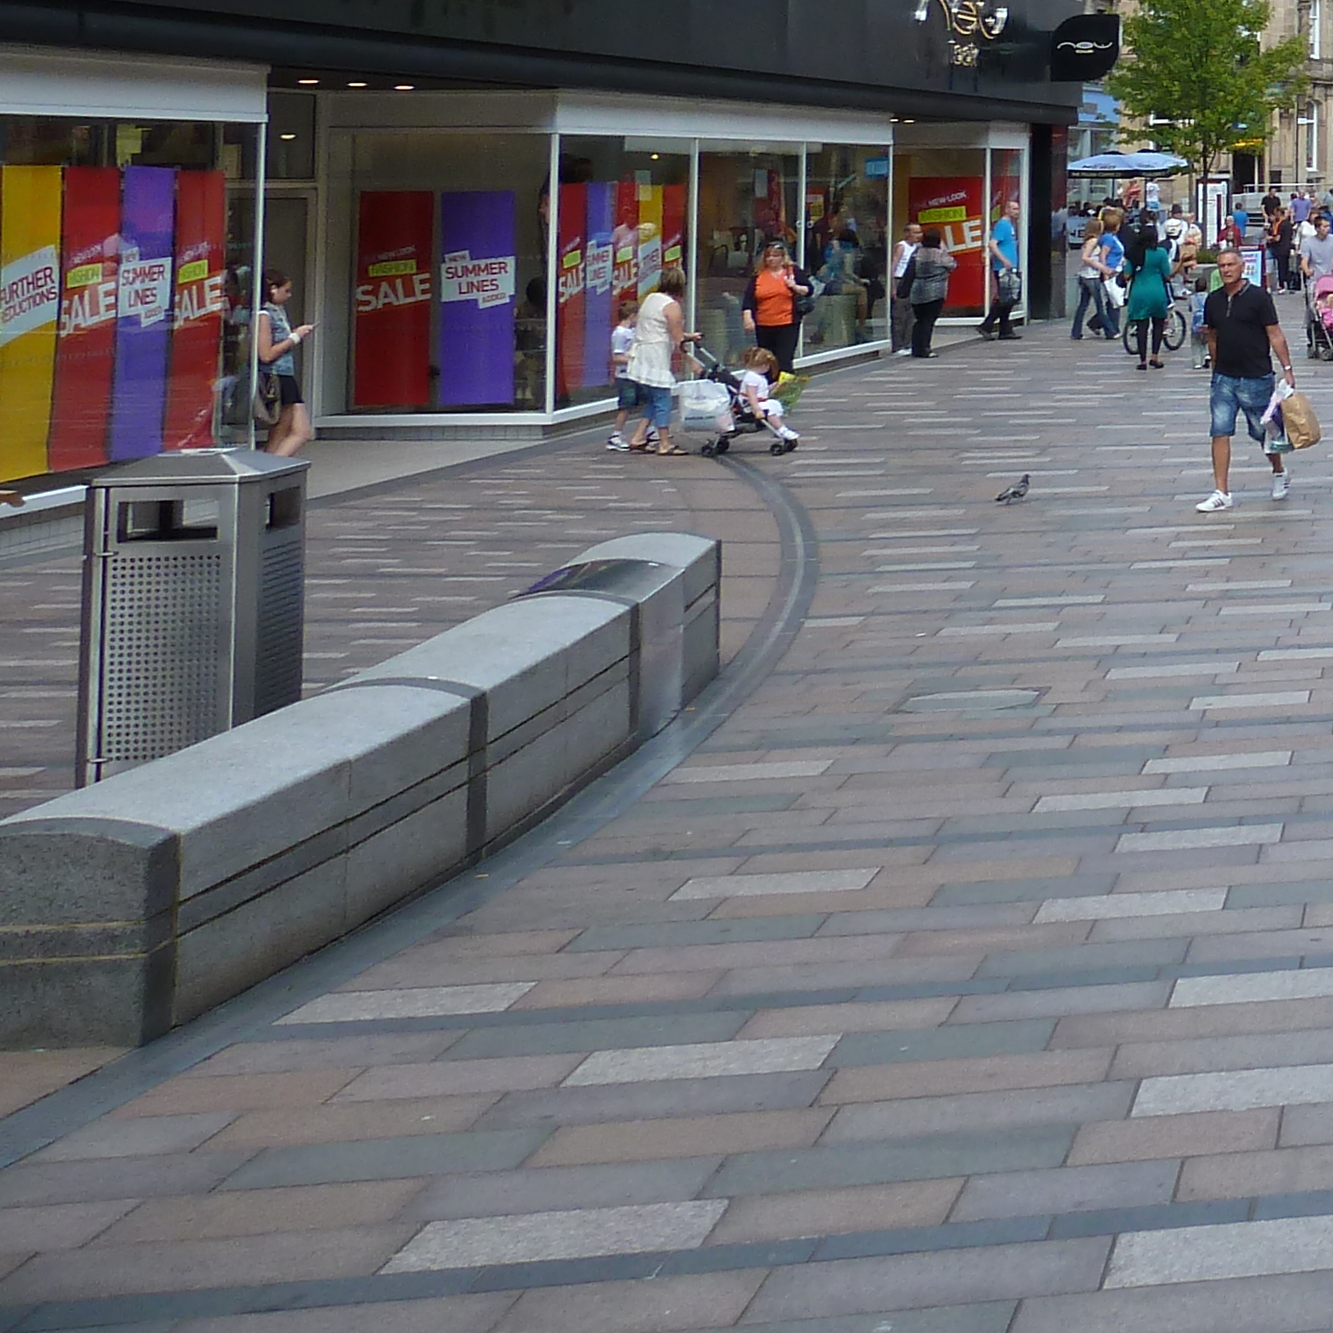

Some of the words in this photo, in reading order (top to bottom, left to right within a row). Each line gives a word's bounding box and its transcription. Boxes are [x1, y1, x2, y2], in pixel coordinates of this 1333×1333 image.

[941, 219, 982, 253] LE
[0, 266, 55, 305] FURTHER
[121, 264, 165, 286] SUMMER
[446, 262, 509, 280] SUMMER
[458, 279, 500, 295] LINES
[1, 285, 58, 324] EDUCTIONS
[61, 282, 115, 337] SALE
[128, 287, 157, 308] LINES
[174, 276, 222, 330] SALE
[355, 273, 433, 312] SALE
